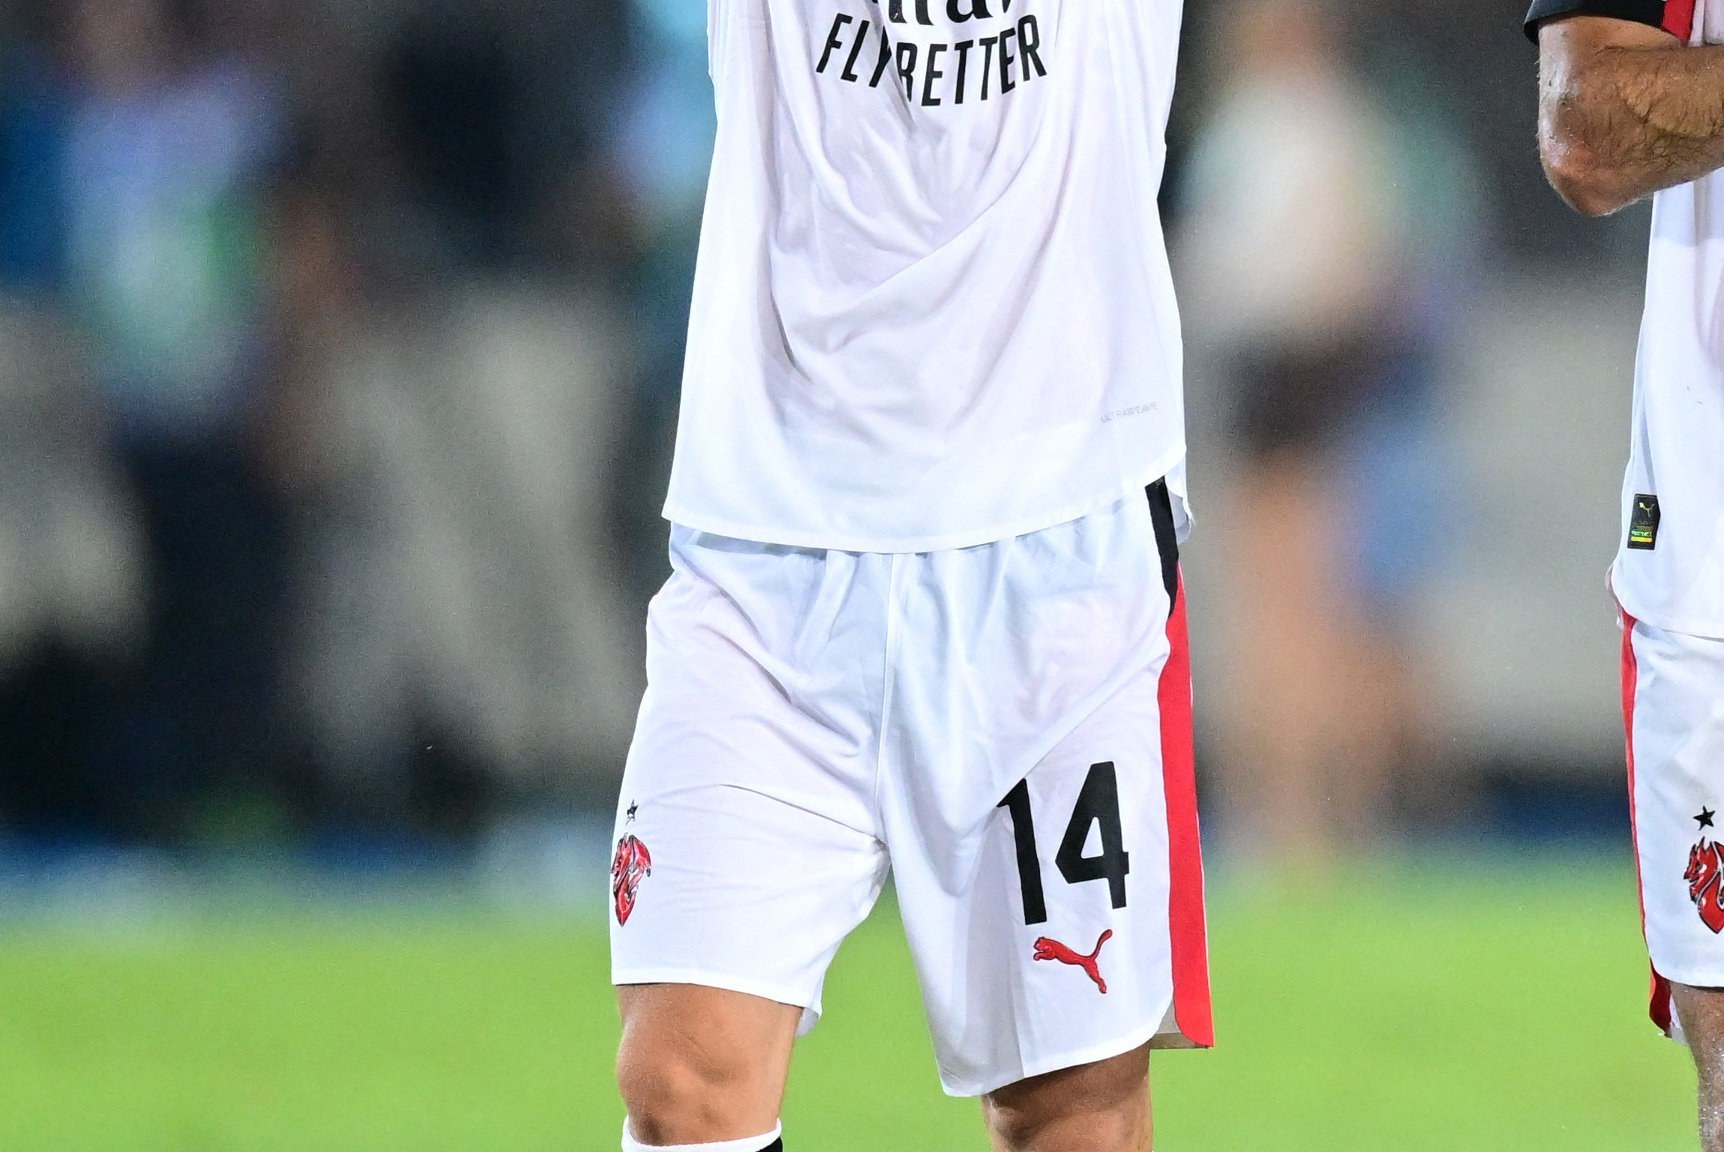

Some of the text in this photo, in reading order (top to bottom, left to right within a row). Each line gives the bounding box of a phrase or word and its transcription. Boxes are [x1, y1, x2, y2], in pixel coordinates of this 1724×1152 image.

[816, 13, 1047, 107] FLY BETTER
[997, 761, 1129, 925] 14
